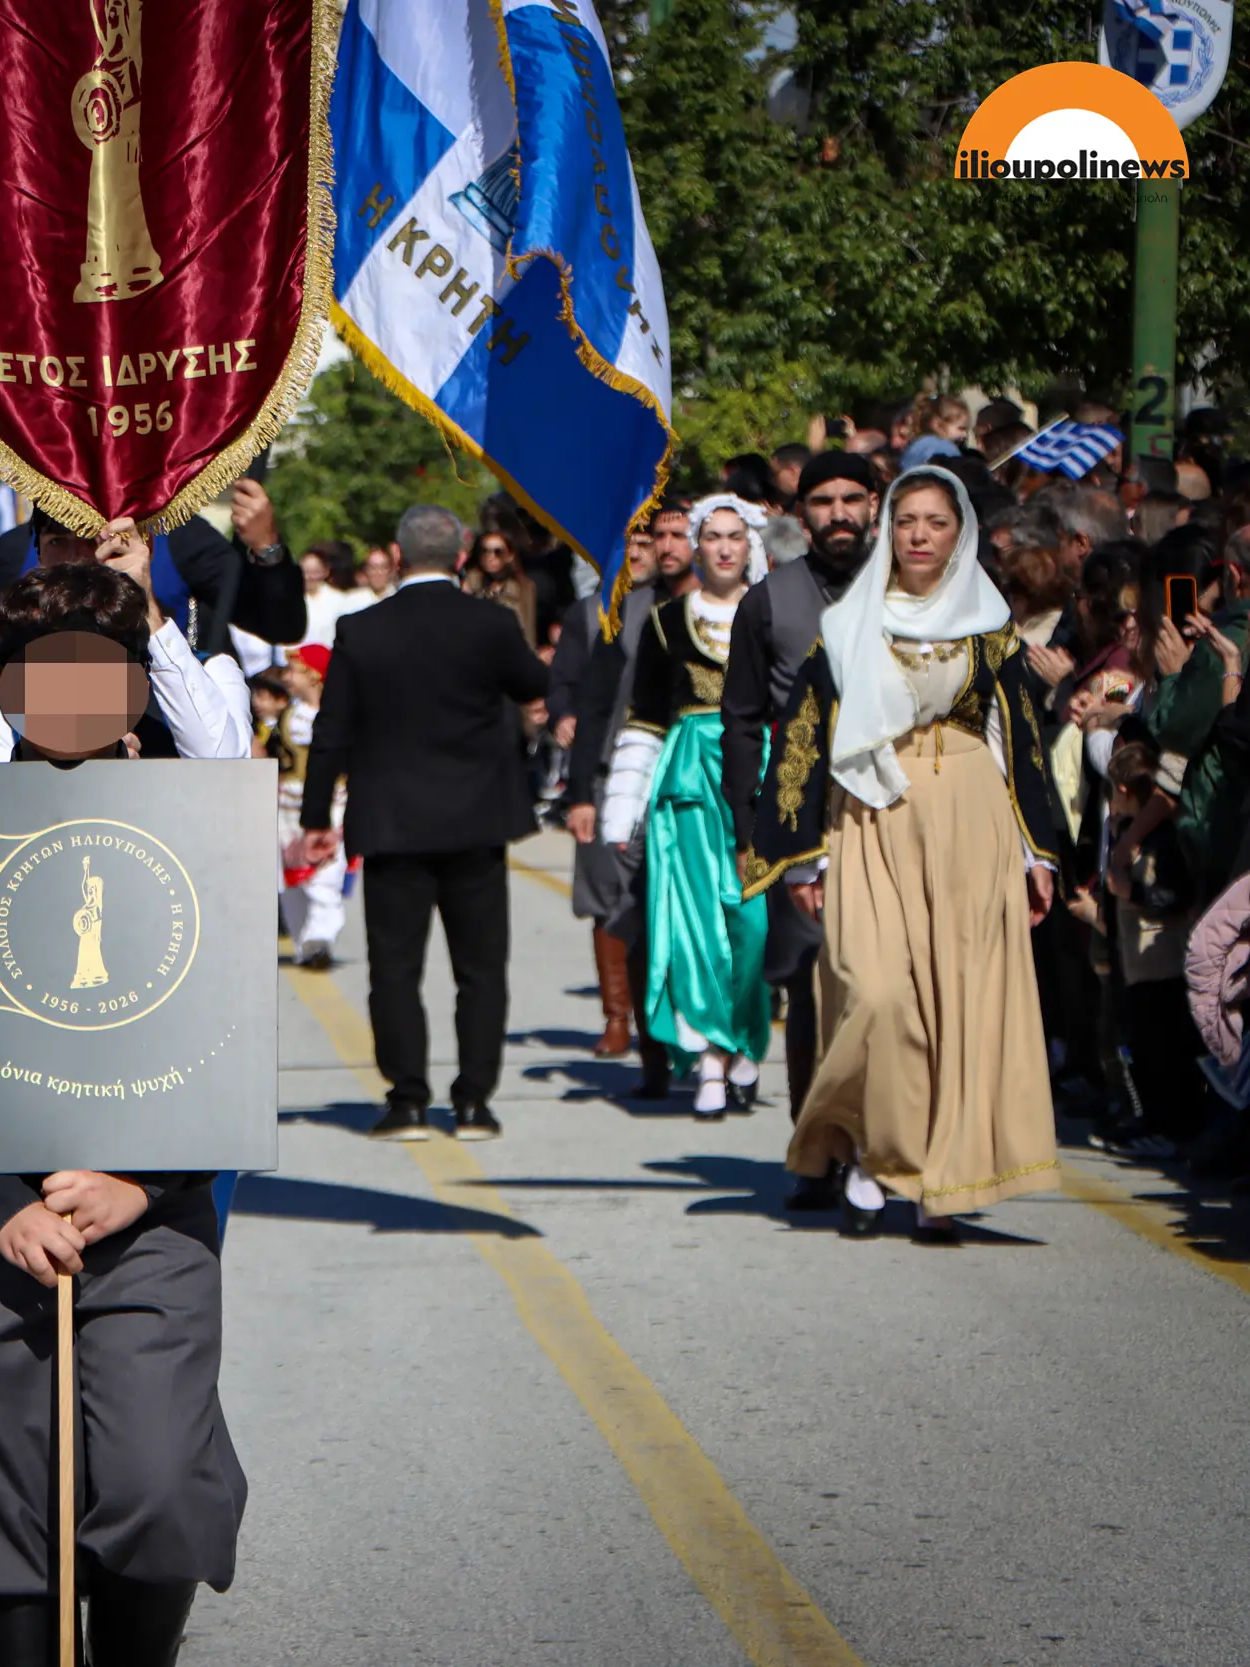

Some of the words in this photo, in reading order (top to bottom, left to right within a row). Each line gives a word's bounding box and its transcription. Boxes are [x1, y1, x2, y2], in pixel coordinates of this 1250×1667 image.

[358, 182, 395, 230] Η
[387, 216, 531, 366] ΚΡΗΤΗ
[102, 339, 258, 387] ΙΔΡΥΣΗΣ
[87, 400, 173, 438] 1956
[1134, 375, 1169, 426] 2
[6, 840, 64, 893] ΚΡΗΤΩΝ
[69, 834, 172, 886] ΗΛΙΟΥΠΟΛΗΣ
[156, 920, 184, 977] ΚΡΗΤΗ
[40, 991, 80, 1014] 1956
[98, 990, 140, 1014] 2026
[47, 1075, 126, 1100] κρητική
[130, 1065, 185, 1098] ψυχή
